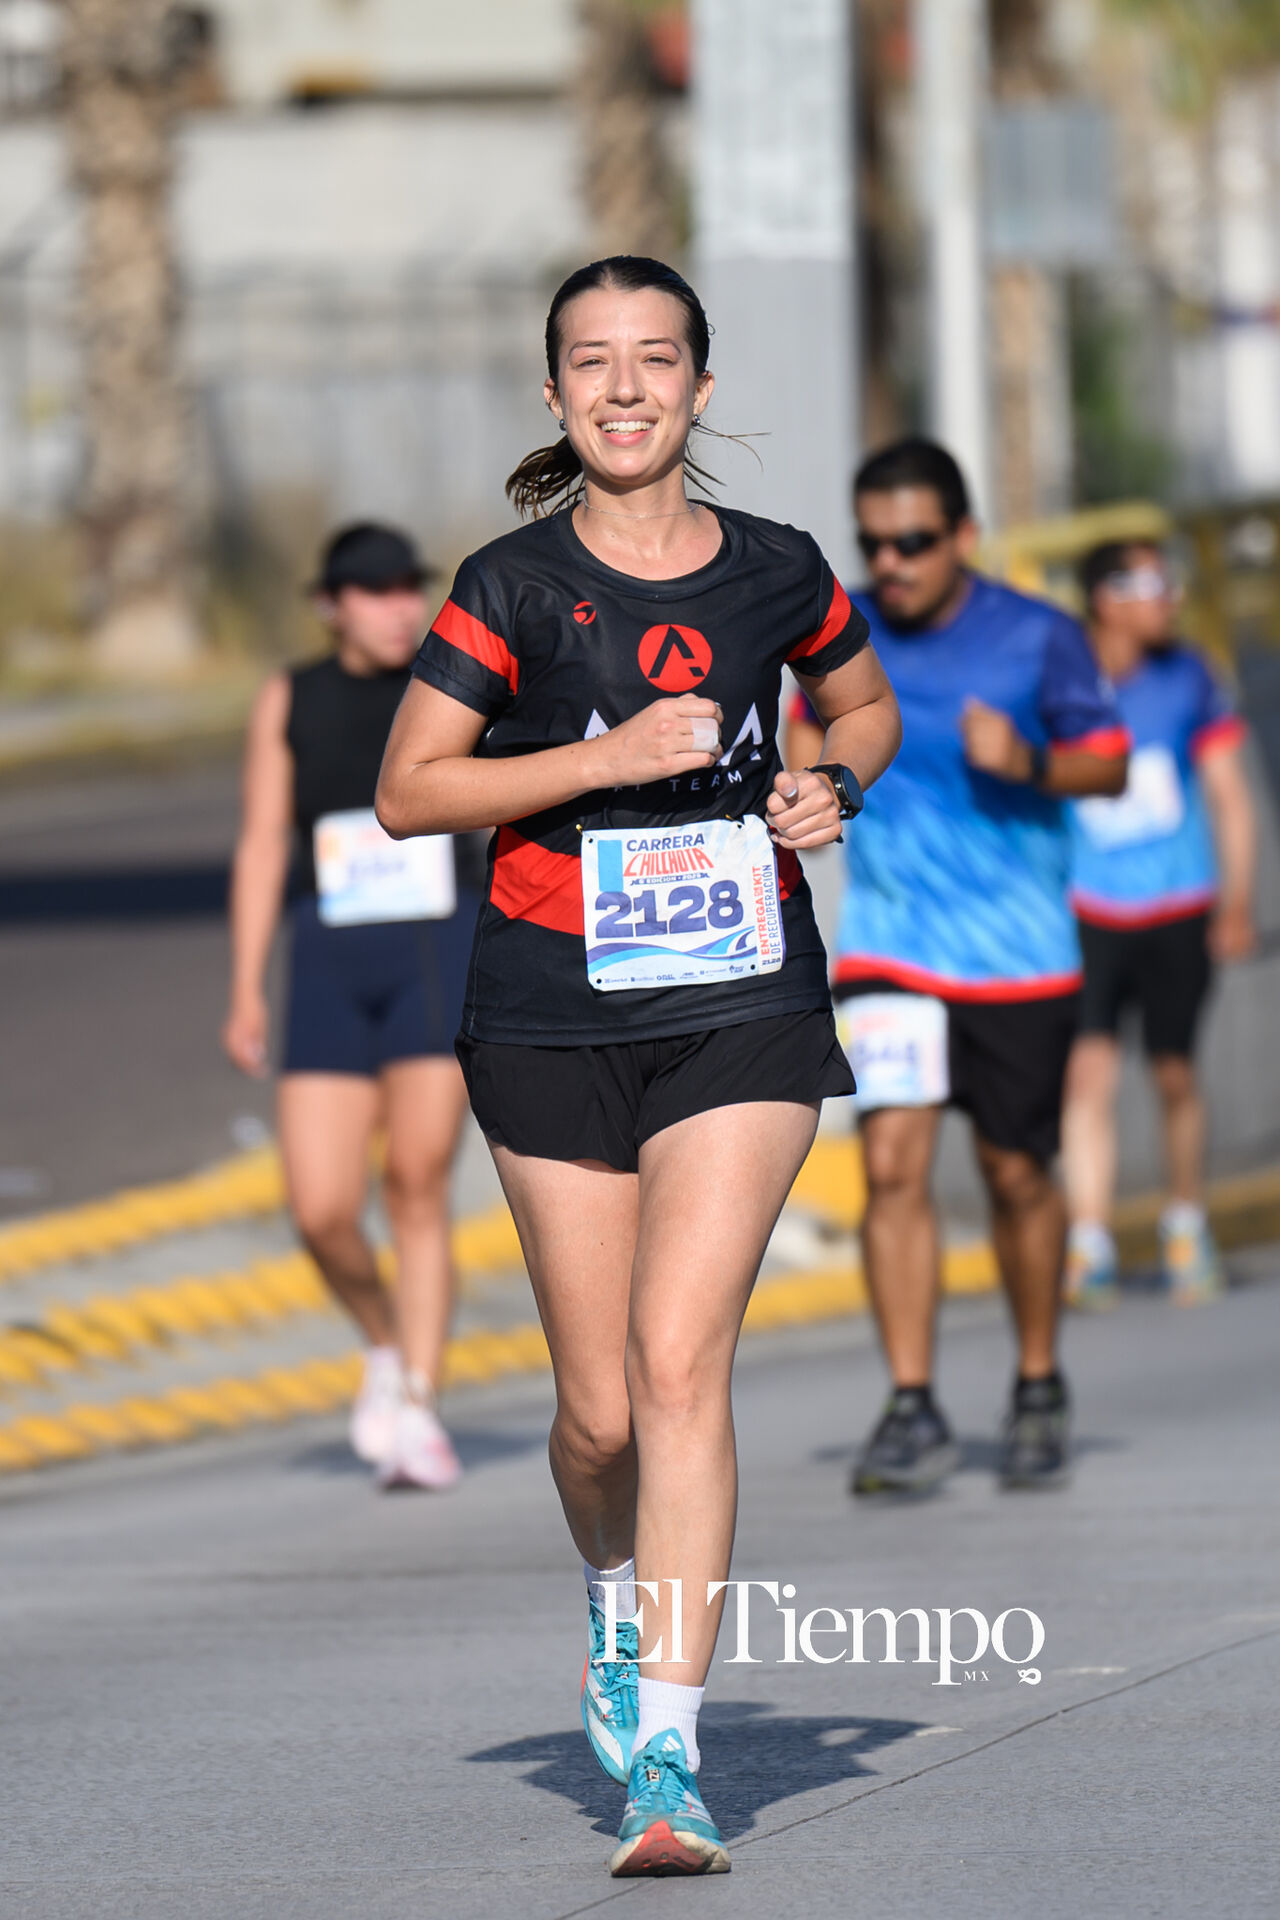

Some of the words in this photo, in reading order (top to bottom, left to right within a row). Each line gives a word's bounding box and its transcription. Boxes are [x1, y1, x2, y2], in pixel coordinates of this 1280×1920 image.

[668, 769, 743, 793] TEAM
[626, 833, 705, 852] CARRERA
[623, 847, 714, 877] CHILCHOTA
[752, 866, 763, 886] KIT
[595, 880, 744, 939] 2128
[762, 864, 779, 938] RECUPERACIÓN
[755, 897, 770, 955] ENTREGA
[770, 941, 781, 955] DE
